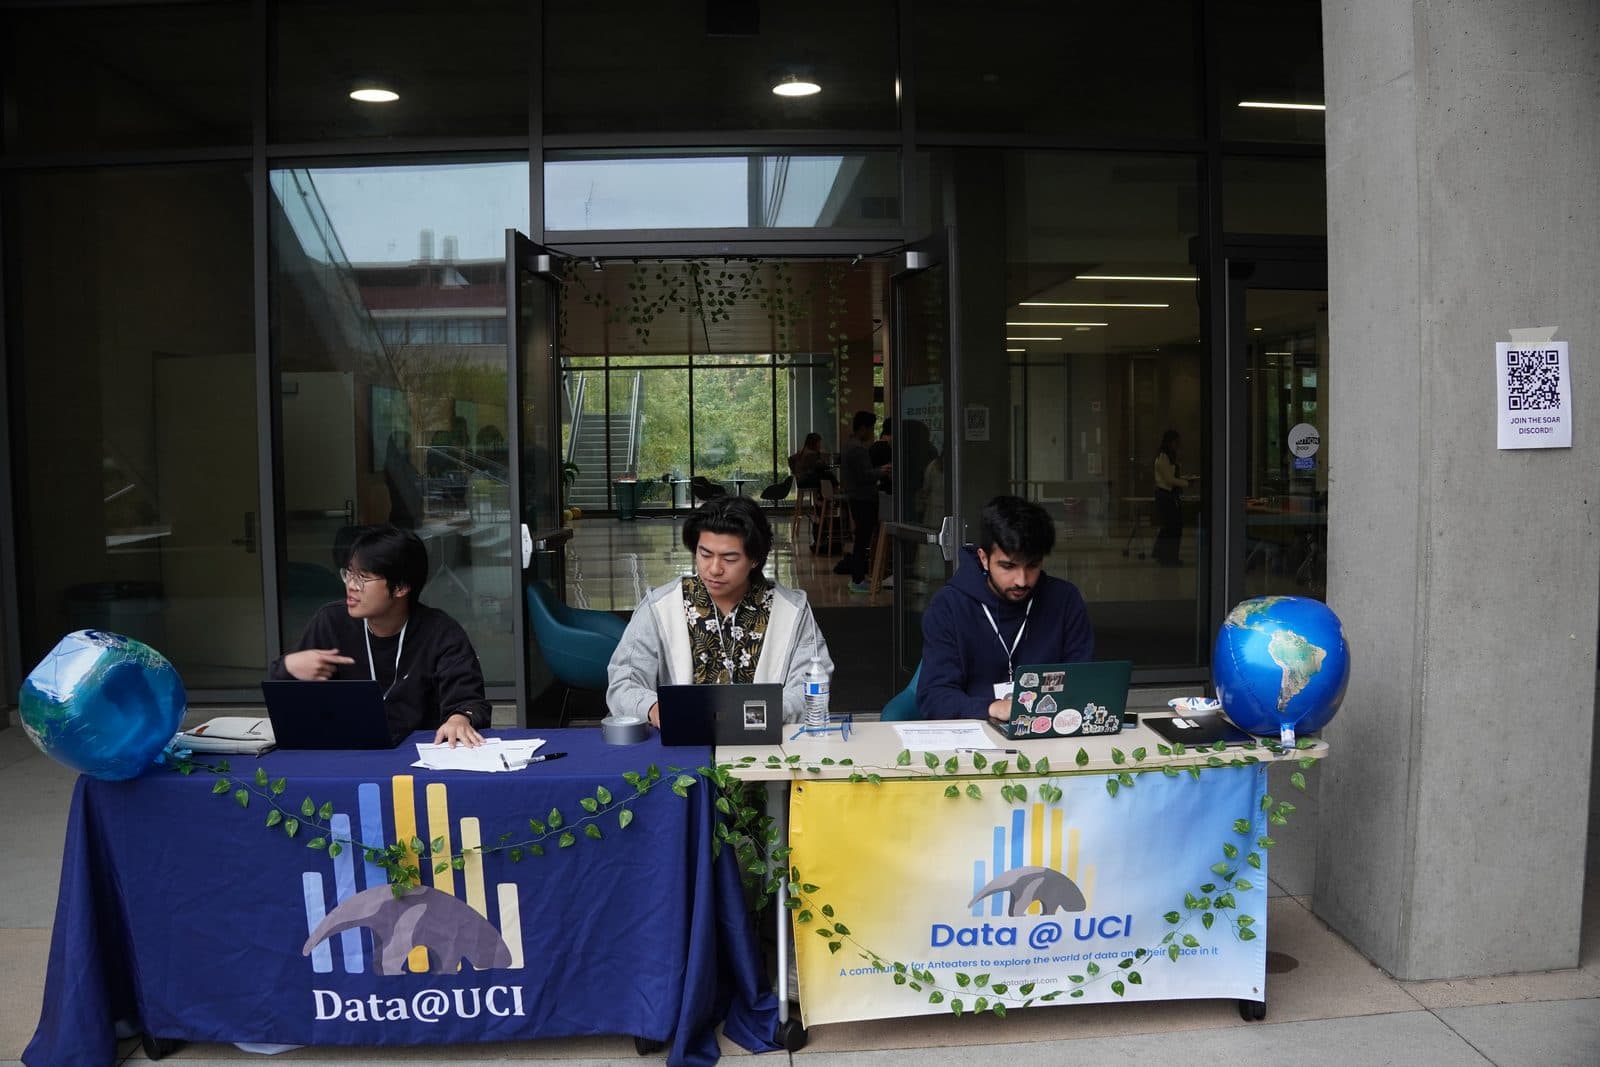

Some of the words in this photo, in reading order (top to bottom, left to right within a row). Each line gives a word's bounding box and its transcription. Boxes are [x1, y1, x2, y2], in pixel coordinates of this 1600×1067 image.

[931, 923, 1017, 947] Data
[1028, 921, 1062, 950] @
[1074, 914, 1132, 941] UCI
[840, 968, 847, 976] A
[849, 964, 909, 976] communy
[928, 959, 978, 969] Anteaters
[981, 959, 991, 967] to
[994, 958, 1031, 968] explore
[1033, 956, 1050, 964] the
[1052, 953, 1080, 962] world
[1083, 952, 1092, 960] of
[1095, 951, 1119, 960] data
[1199, 946, 1209, 955] in
[1211, 945, 1219, 955] it
[312, 985, 526, 1022] Data@UCI
